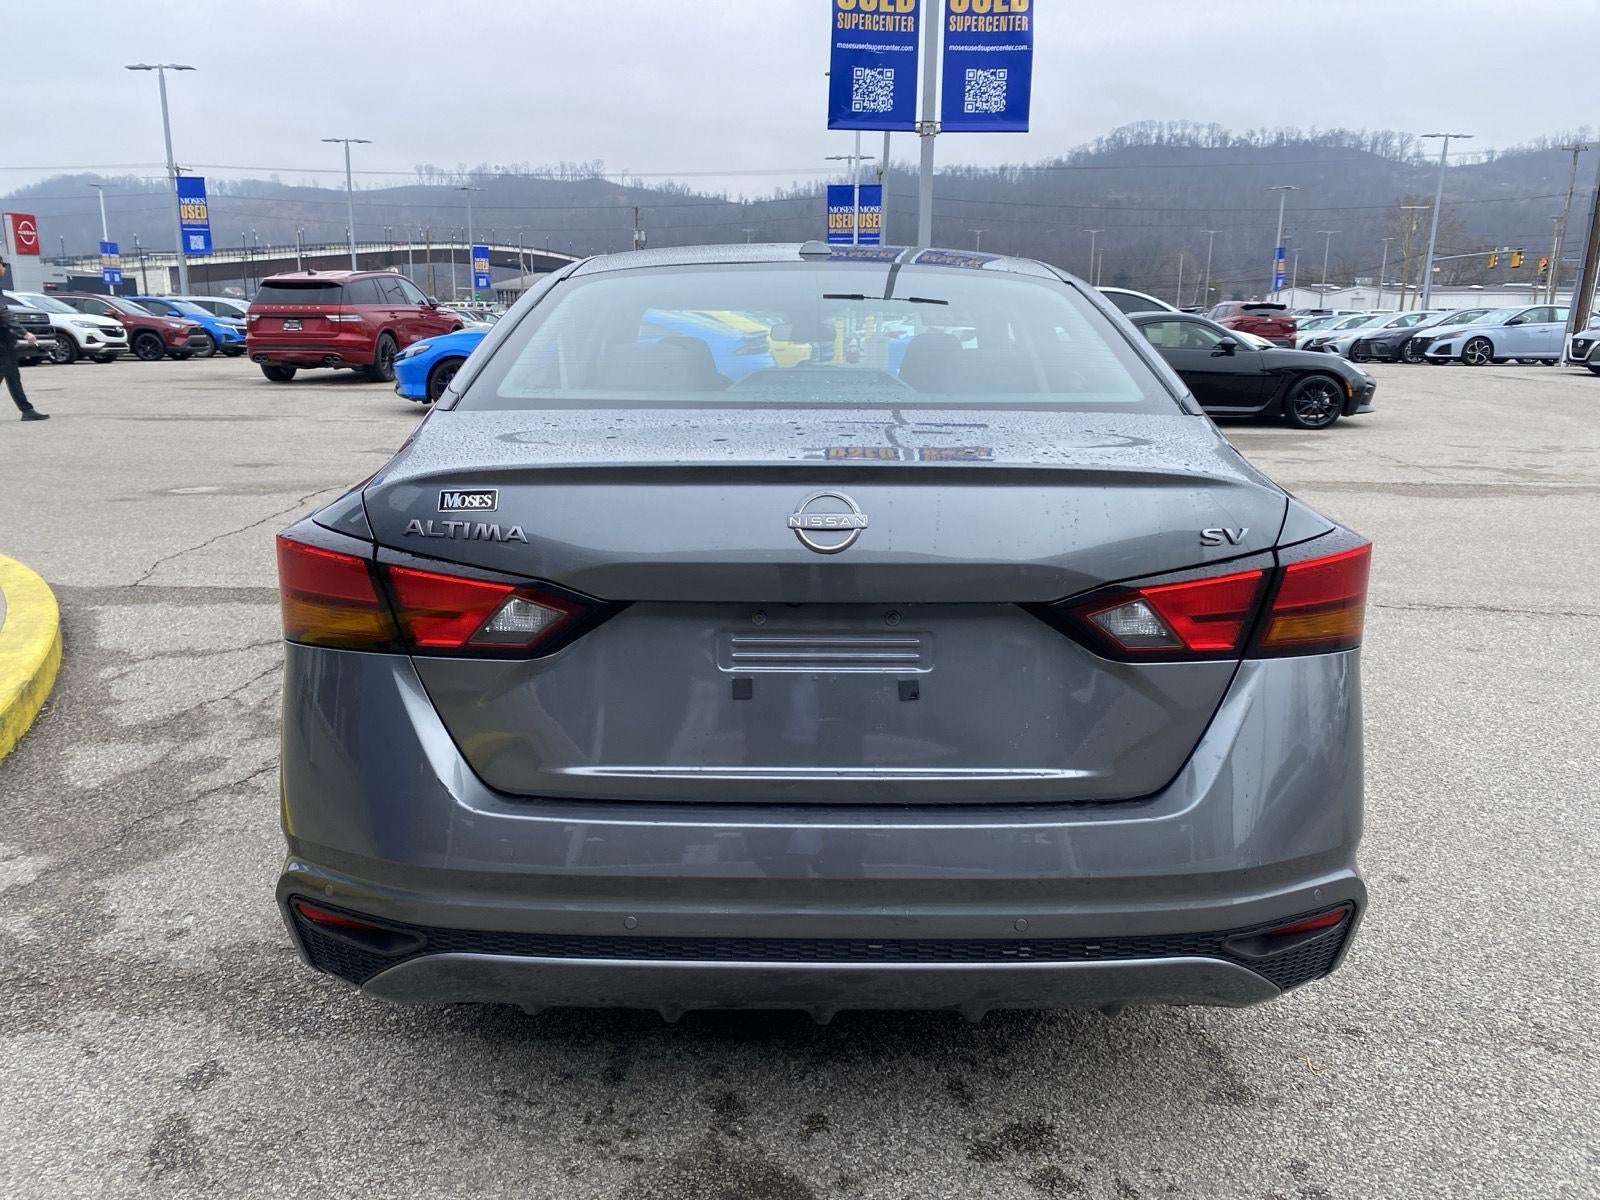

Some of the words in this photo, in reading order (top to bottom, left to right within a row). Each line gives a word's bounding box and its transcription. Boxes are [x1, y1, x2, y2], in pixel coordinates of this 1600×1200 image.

[837, 12, 914, 32] SUPERCENTER
[949, 15, 1029, 32] SUPERCENTER
[836, 42, 914, 52] mosesusedsupercenter.com
[948, 44, 1028, 52] mosesusedsupercenter.com
[180, 197, 206, 205] MOSES
[181, 205, 207, 219] USED
[829, 213, 853, 228] USED
[789, 516, 866, 526] NISSAN
[403, 519, 529, 544] ALTIMA
[1200, 528, 1249, 546] SV
